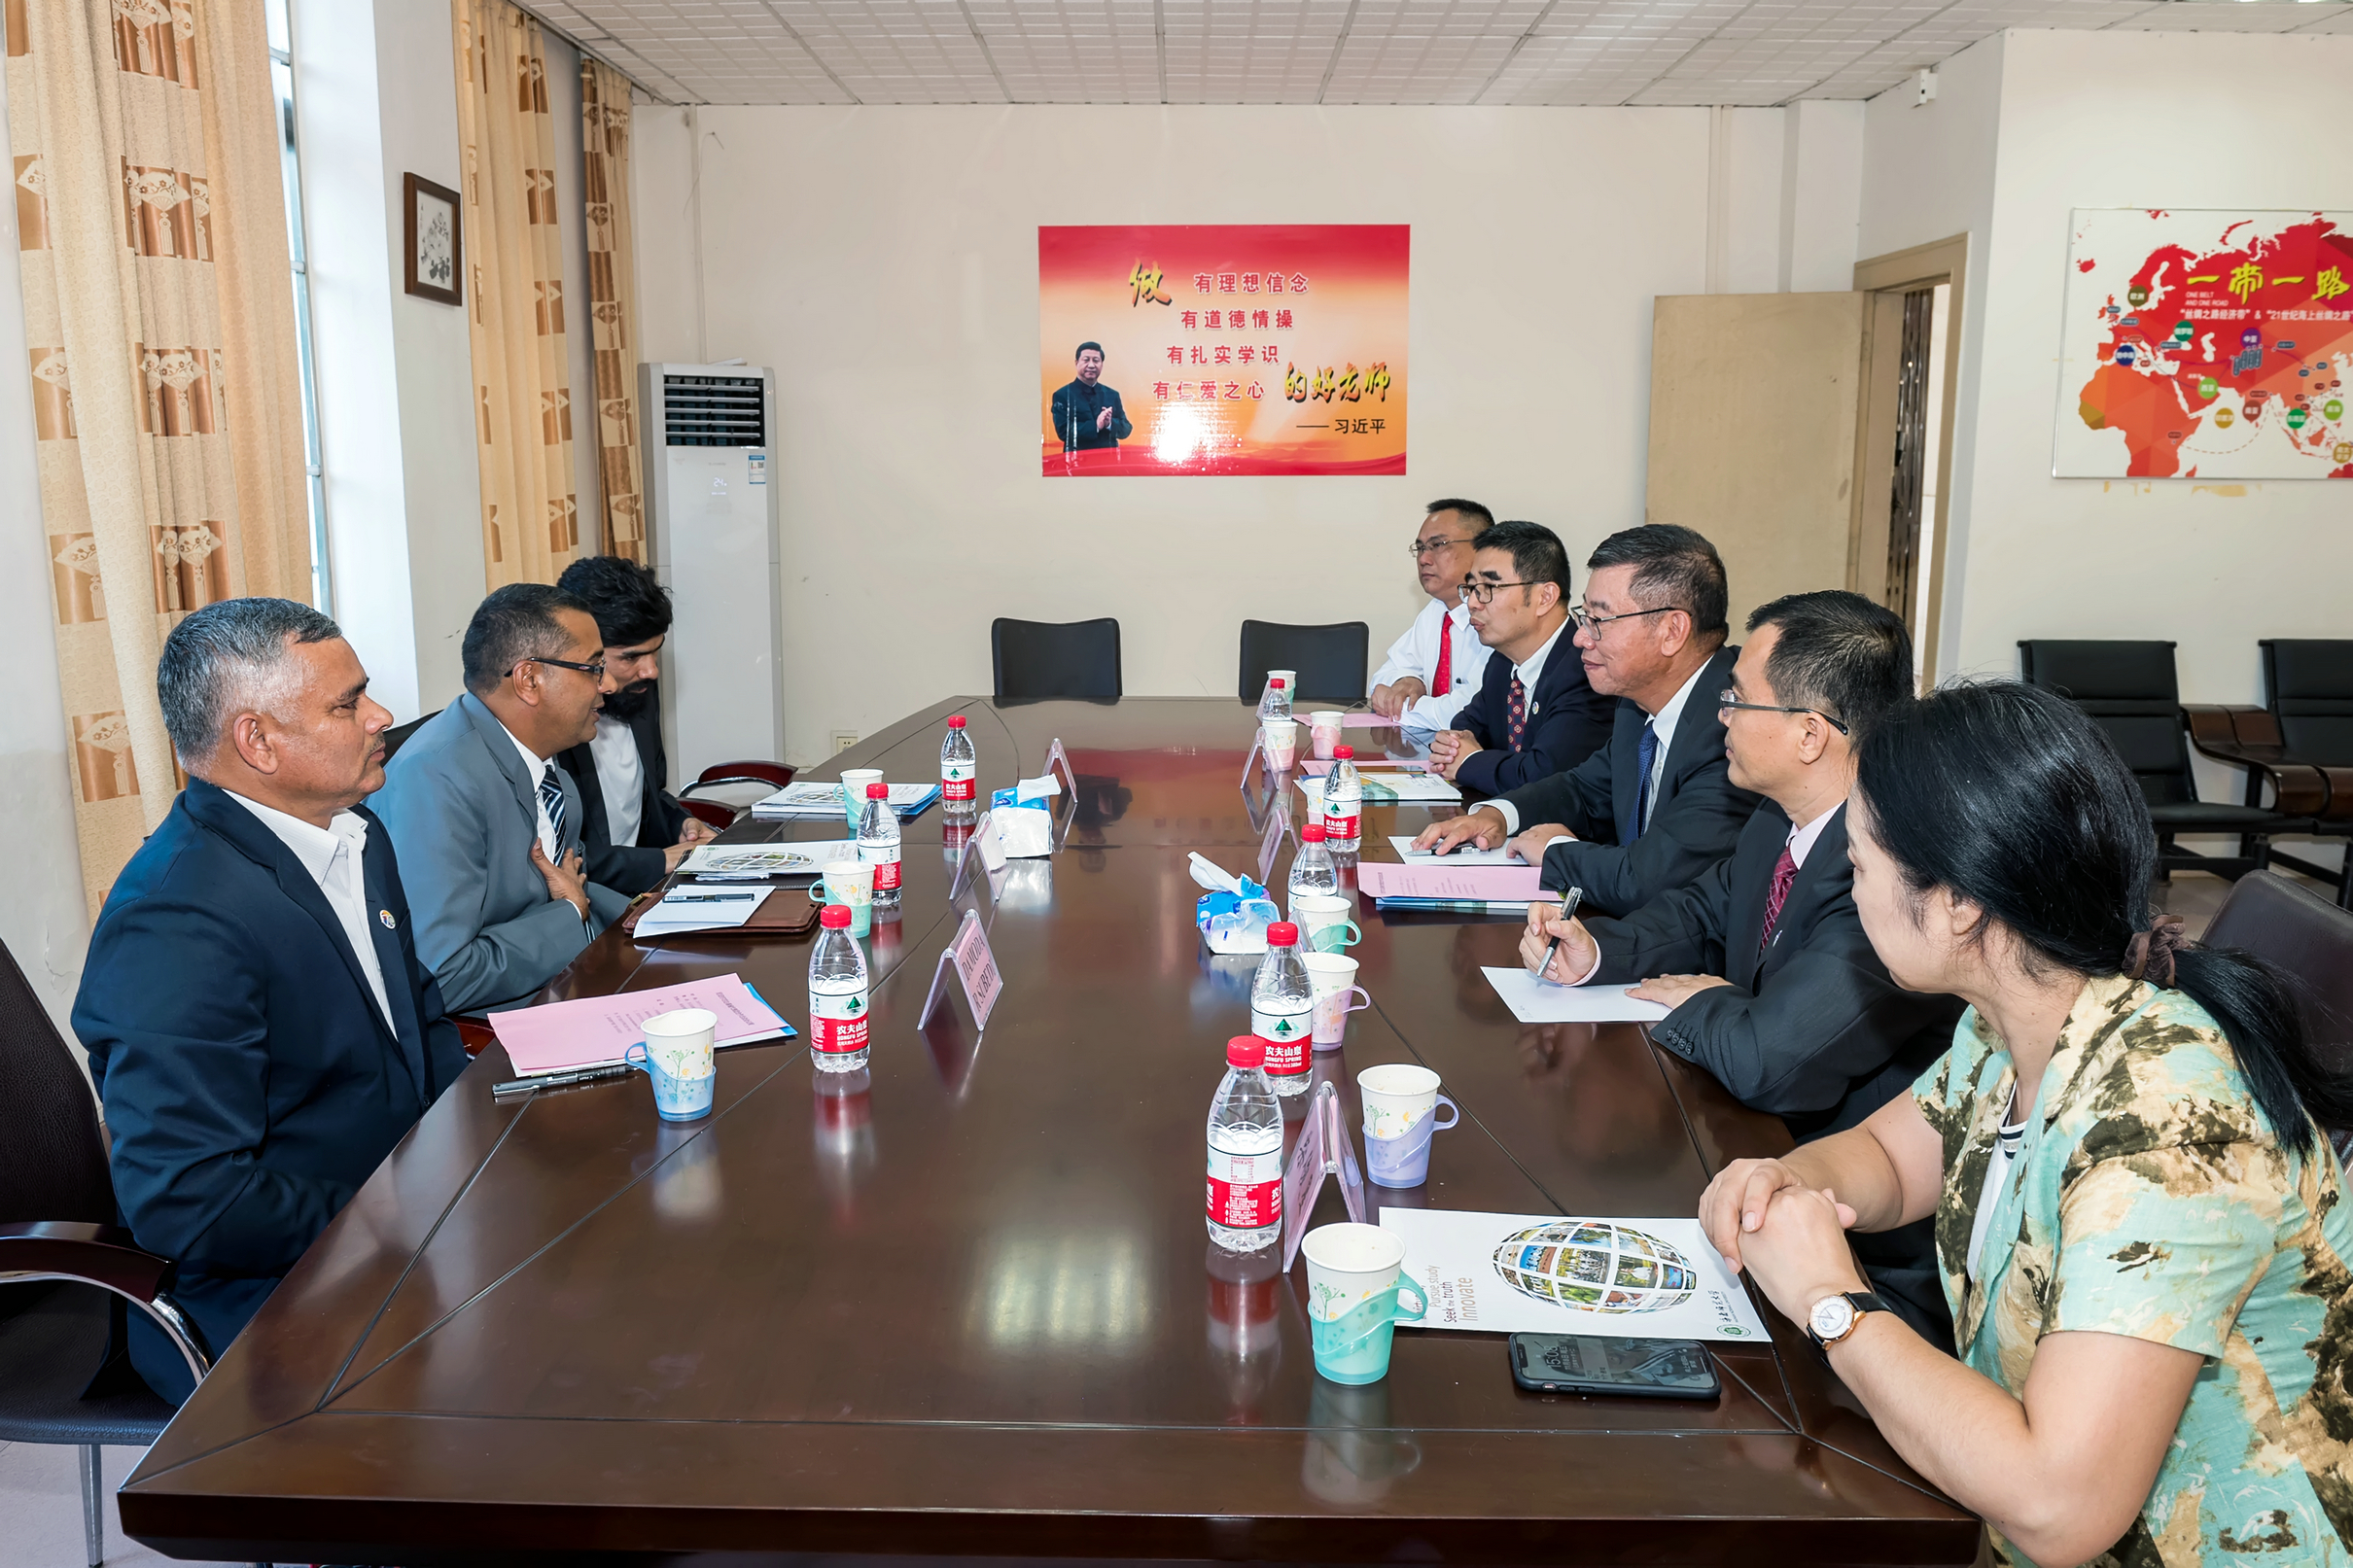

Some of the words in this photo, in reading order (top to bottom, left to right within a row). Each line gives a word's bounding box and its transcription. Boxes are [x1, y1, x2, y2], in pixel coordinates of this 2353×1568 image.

[1129, 258, 1173, 307] 做
[1193, 272, 1310, 295] 有理想信念
[2187, 261, 2351, 305] 一带一路
[1180, 309, 1294, 330] 有道德情操
[1166, 345, 1280, 366] 有扎实学识
[1152, 380, 1265, 401] 有仁爱之心
[1283, 361, 1391, 403] 的好老师
[1265, 1044, 1302, 1057] 农夫山泉
[1425, 1265, 1440, 1283] study
[1429, 1285, 1441, 1307] Pursue
[1439, 1281, 1454, 1298] truth
[1456, 1277, 1478, 1321] Innovate
[1442, 1307, 1457, 1322] Seek
[1544, 1345, 1561, 1368] 15:08
